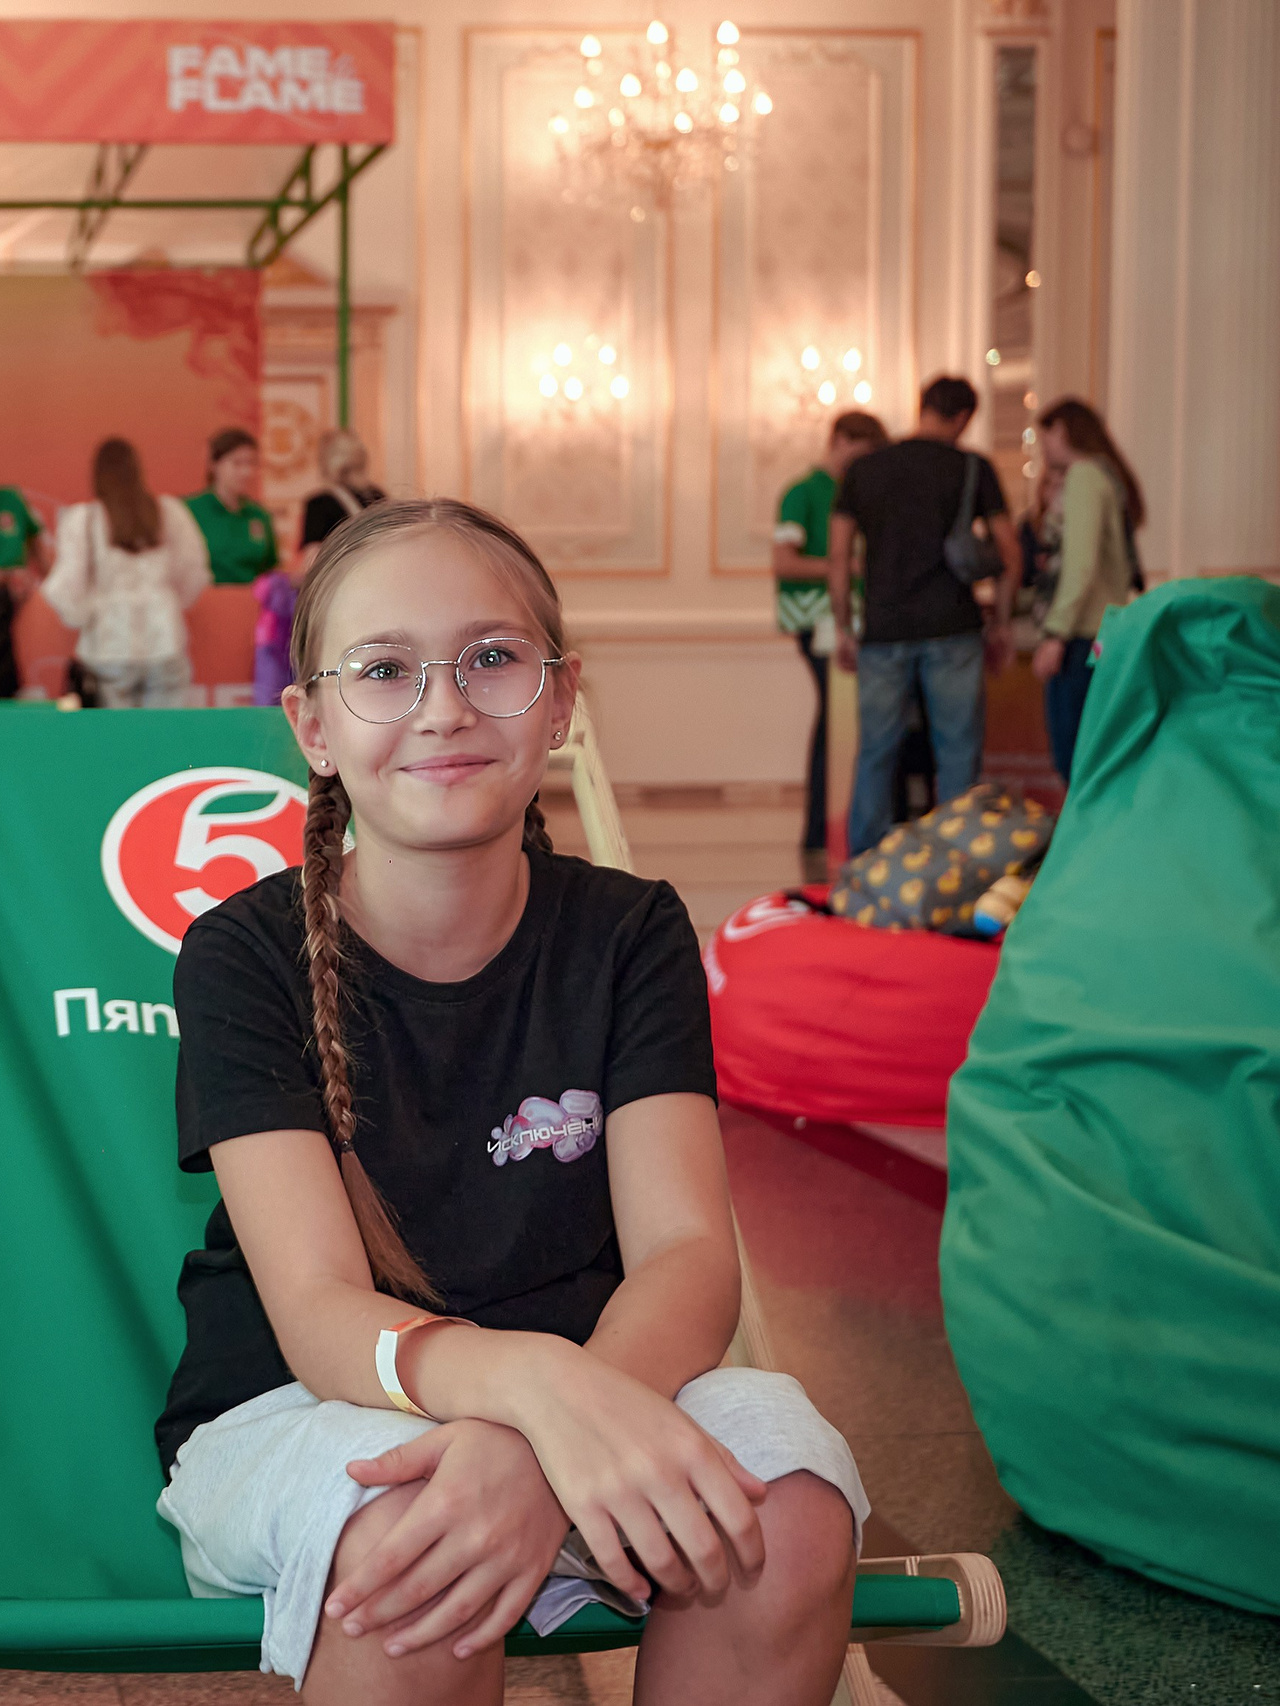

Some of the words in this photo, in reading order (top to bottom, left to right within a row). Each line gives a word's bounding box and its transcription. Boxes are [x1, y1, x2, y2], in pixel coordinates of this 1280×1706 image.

[169, 46, 328, 79] FAME
[169, 80, 365, 114] FLAME
[53, 986, 181, 1038] Пят
